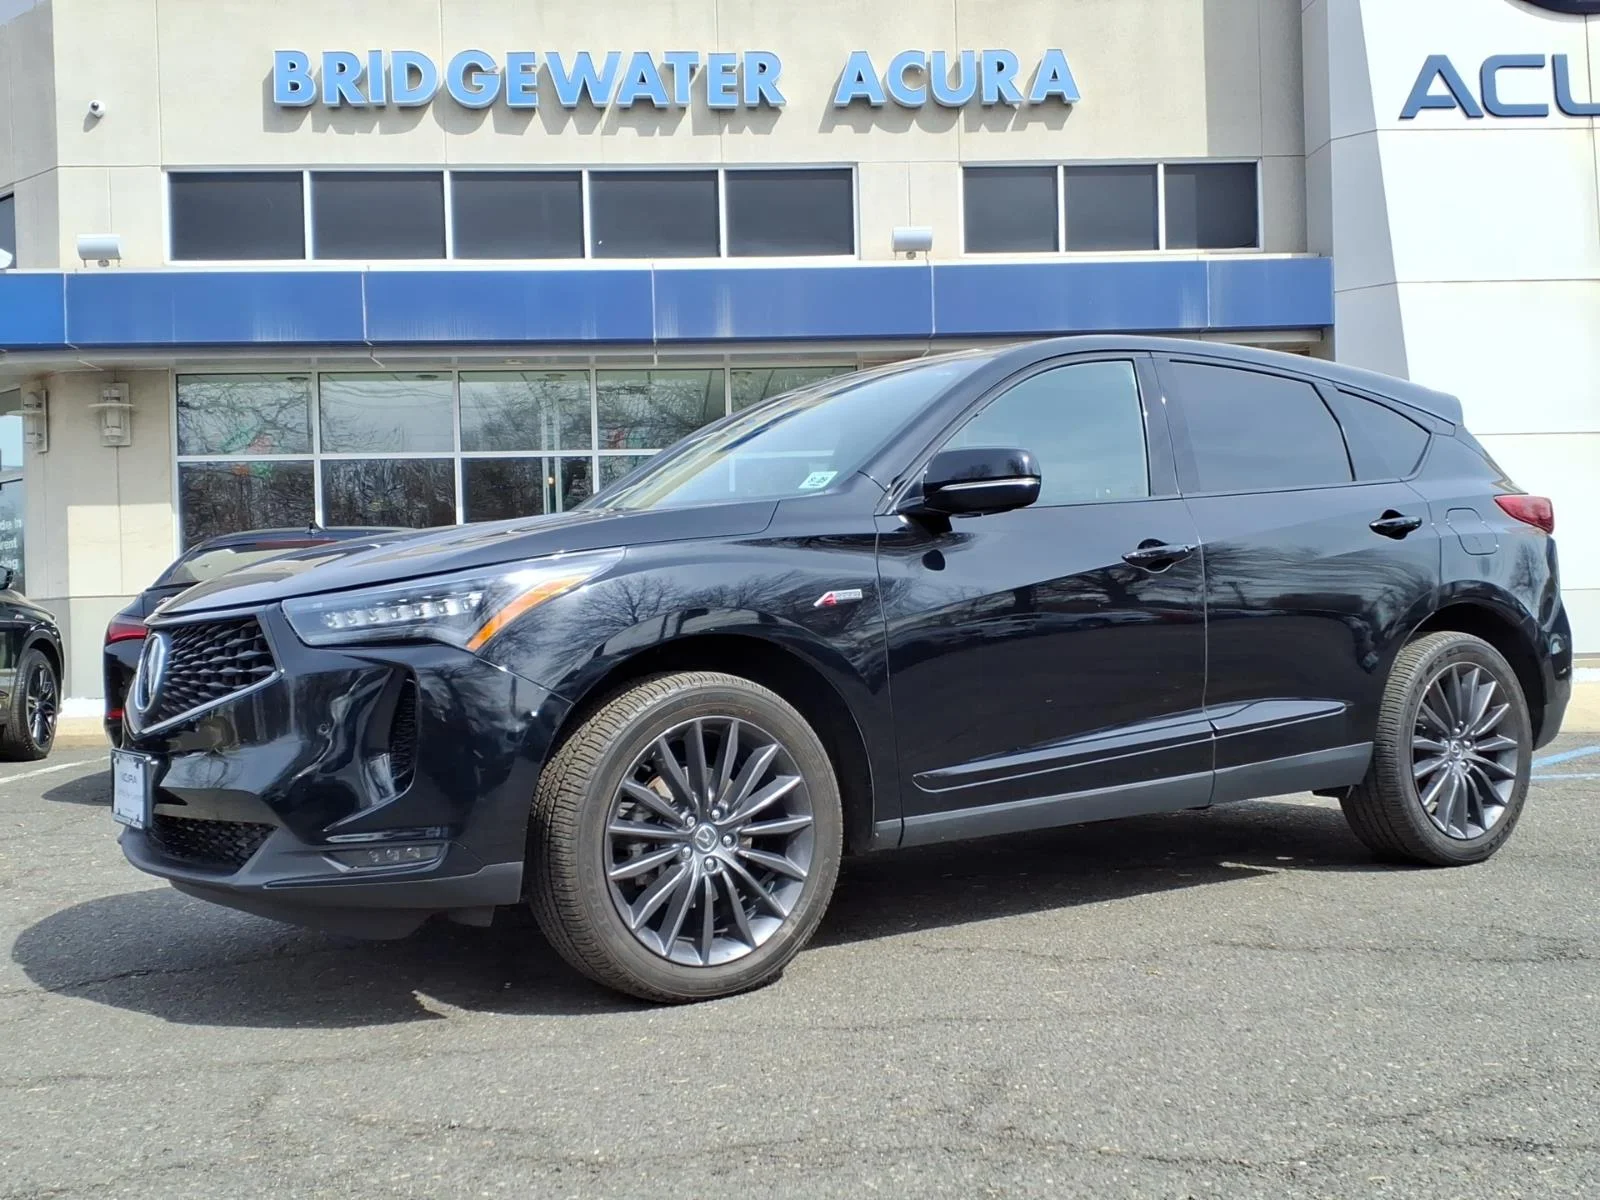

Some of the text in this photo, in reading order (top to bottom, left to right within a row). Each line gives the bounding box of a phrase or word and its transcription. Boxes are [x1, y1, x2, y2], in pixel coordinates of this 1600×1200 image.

[271, 48, 1081, 110] BRIDGEWATER ACURA
[1399, 53, 1600, 119] ACU
